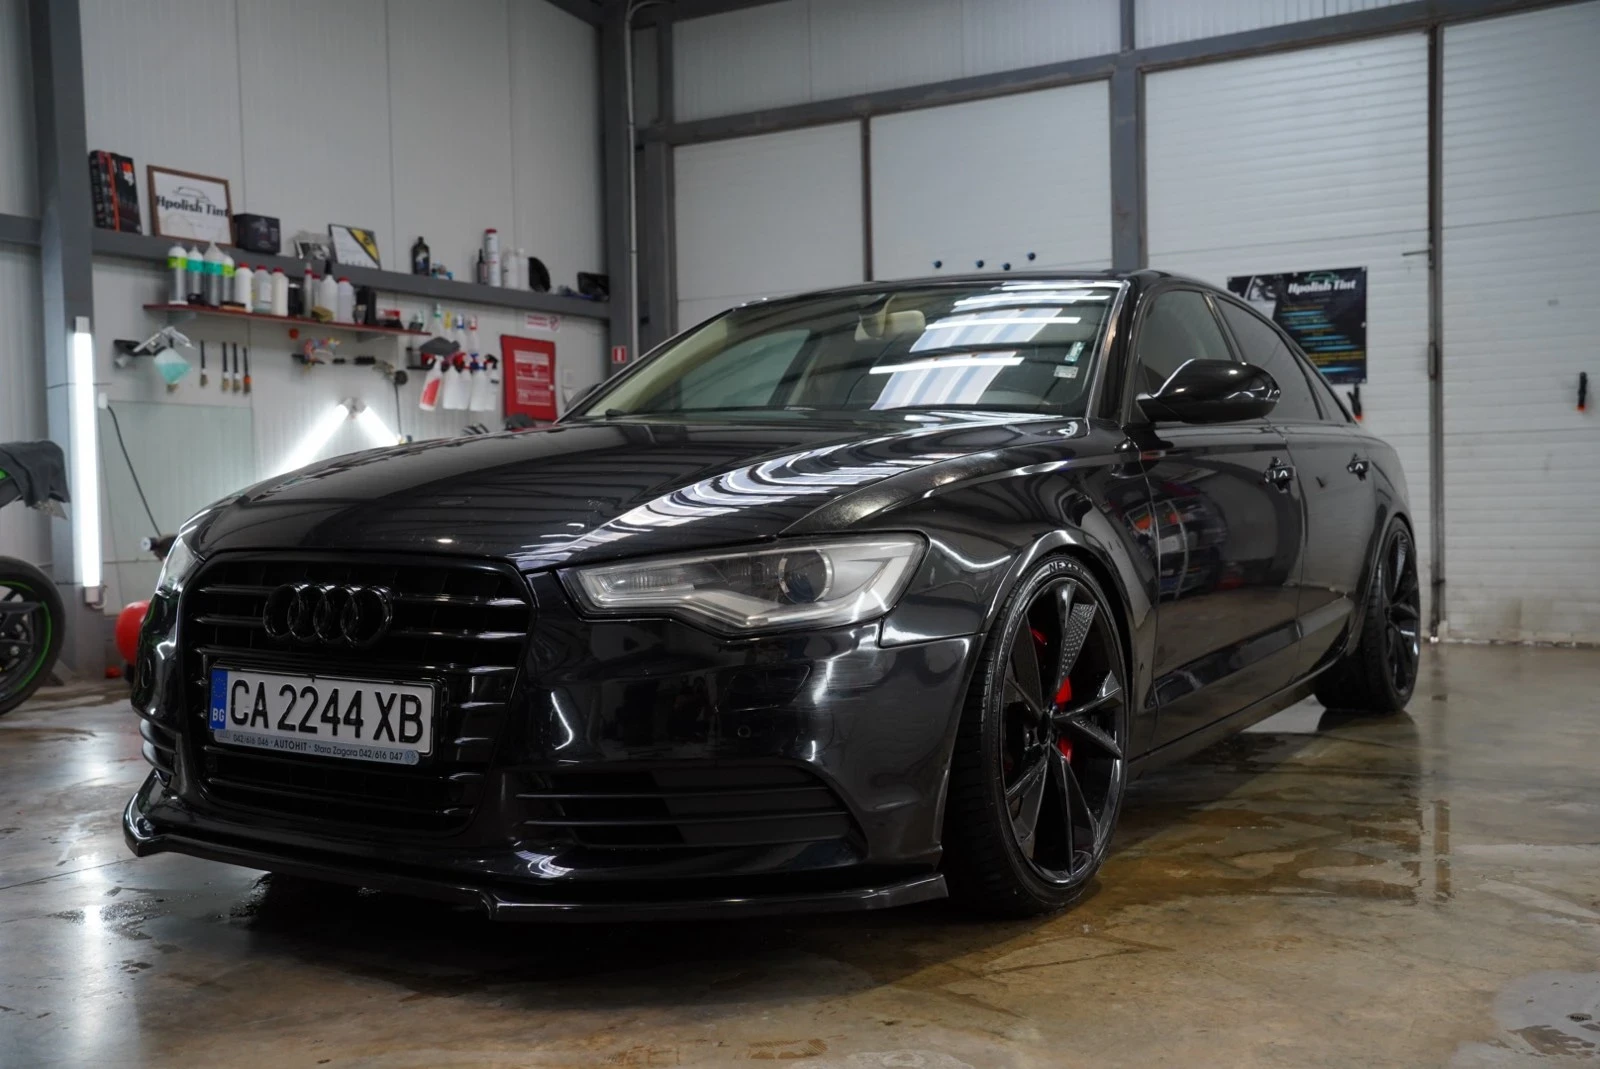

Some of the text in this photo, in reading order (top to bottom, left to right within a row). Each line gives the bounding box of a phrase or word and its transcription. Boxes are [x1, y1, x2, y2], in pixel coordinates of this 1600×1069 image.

[155, 195, 229, 217] Hpolish Tint
[1288, 279, 1357, 294] Hpolish Tint
[212, 707, 225, 722] BG
[230, 679, 424, 744] CA 2244 XB
[274, 739, 307, 751] AUTOHIT
[314, 743, 331, 754] Stara
[359, 748, 387, 760] 042/616
[389, 751, 403, 761] 047
